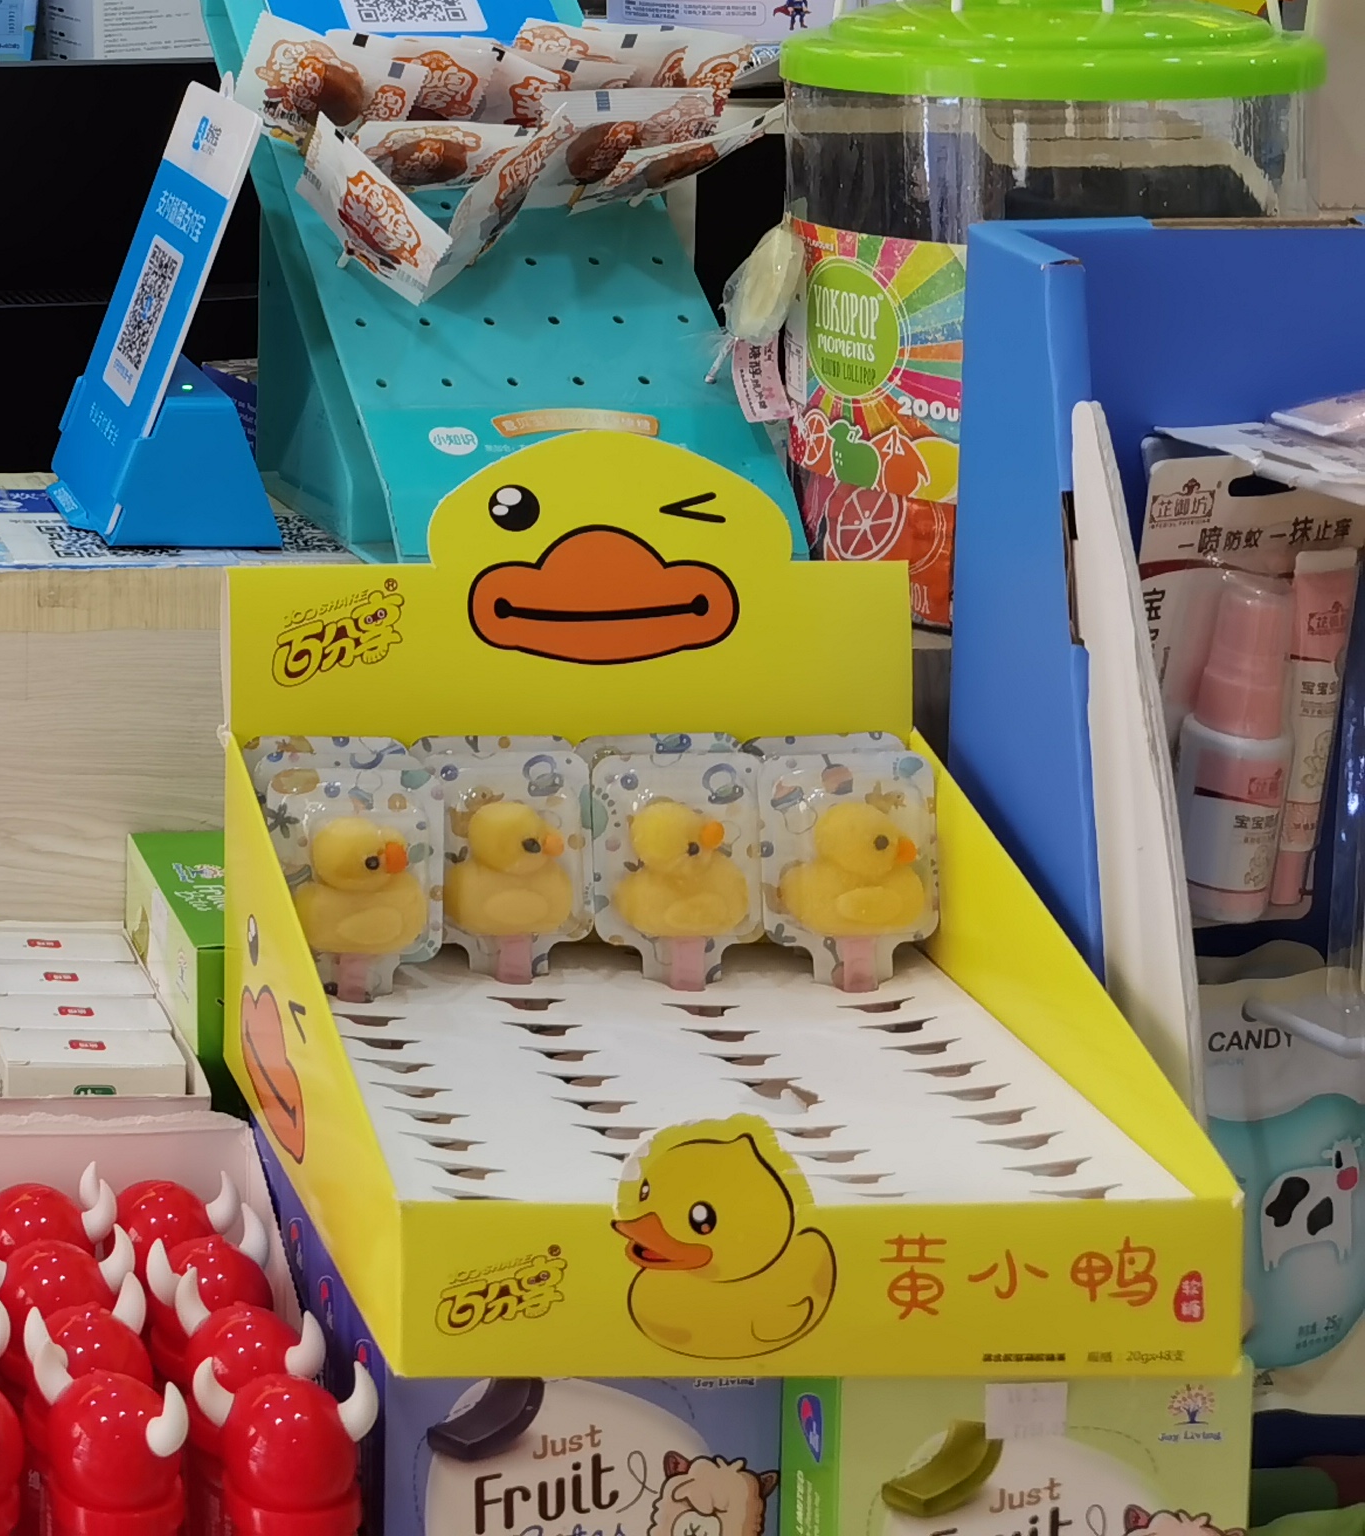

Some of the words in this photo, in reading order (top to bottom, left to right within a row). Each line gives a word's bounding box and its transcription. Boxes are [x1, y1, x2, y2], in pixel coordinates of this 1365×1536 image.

[813, 284, 880, 342] YOKOPOP
[816, 334, 876, 363] MOMENTS
[880, 1231, 1160, 1322] 黄小鸭
[531, 1423, 603, 1461] Just
[473, 1453, 621, 1535] Fruit
[988, 1478, 1062, 1514] Just
